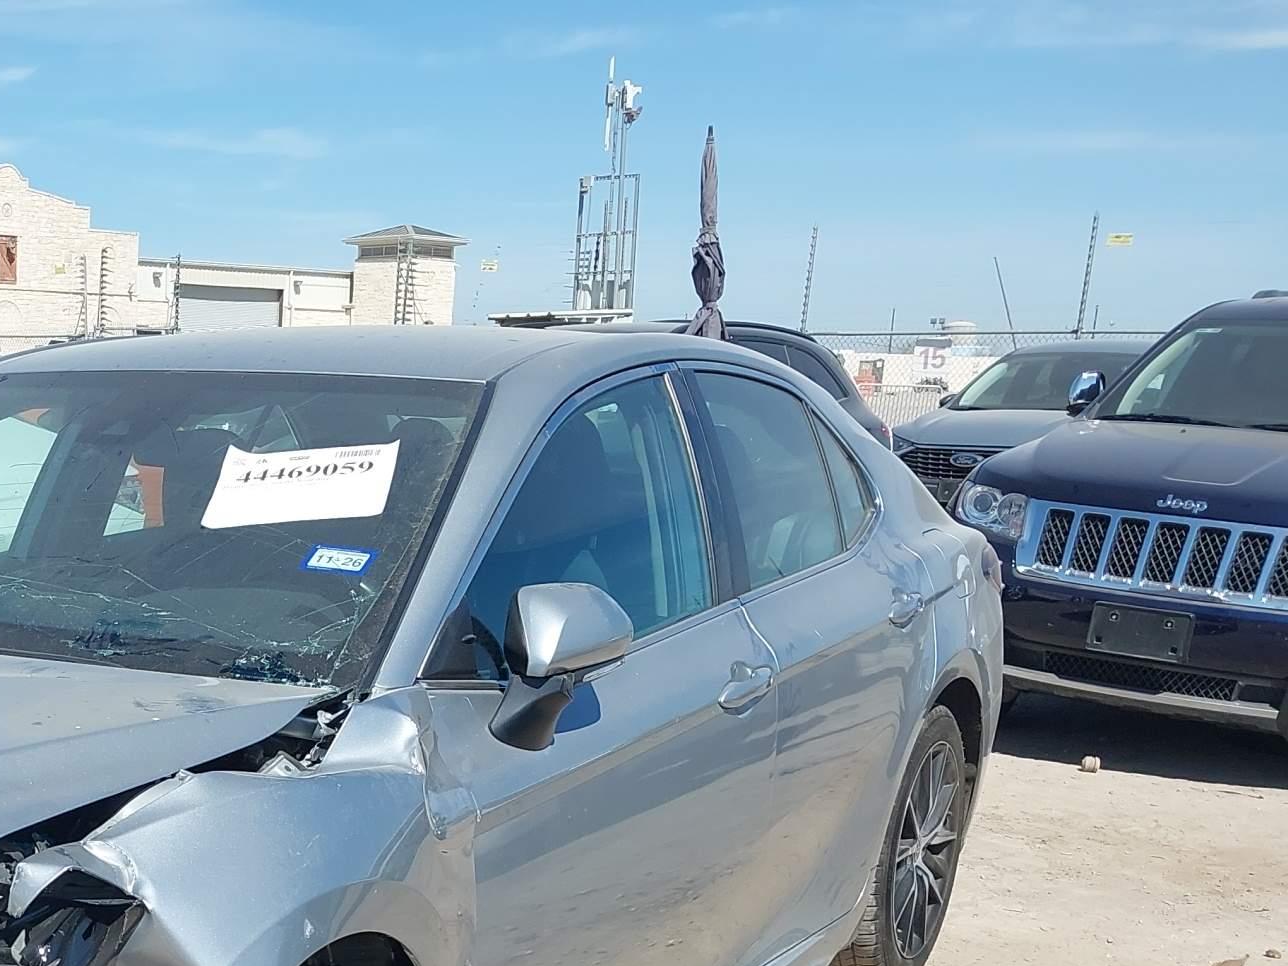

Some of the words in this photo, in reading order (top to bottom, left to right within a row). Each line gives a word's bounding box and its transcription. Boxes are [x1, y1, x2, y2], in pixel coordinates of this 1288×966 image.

[919, 347, 946, 369] 15
[236, 460, 374, 483] 44469059
[1156, 494, 1208, 514] Jeep
[341, 557, 364, 568] 26
